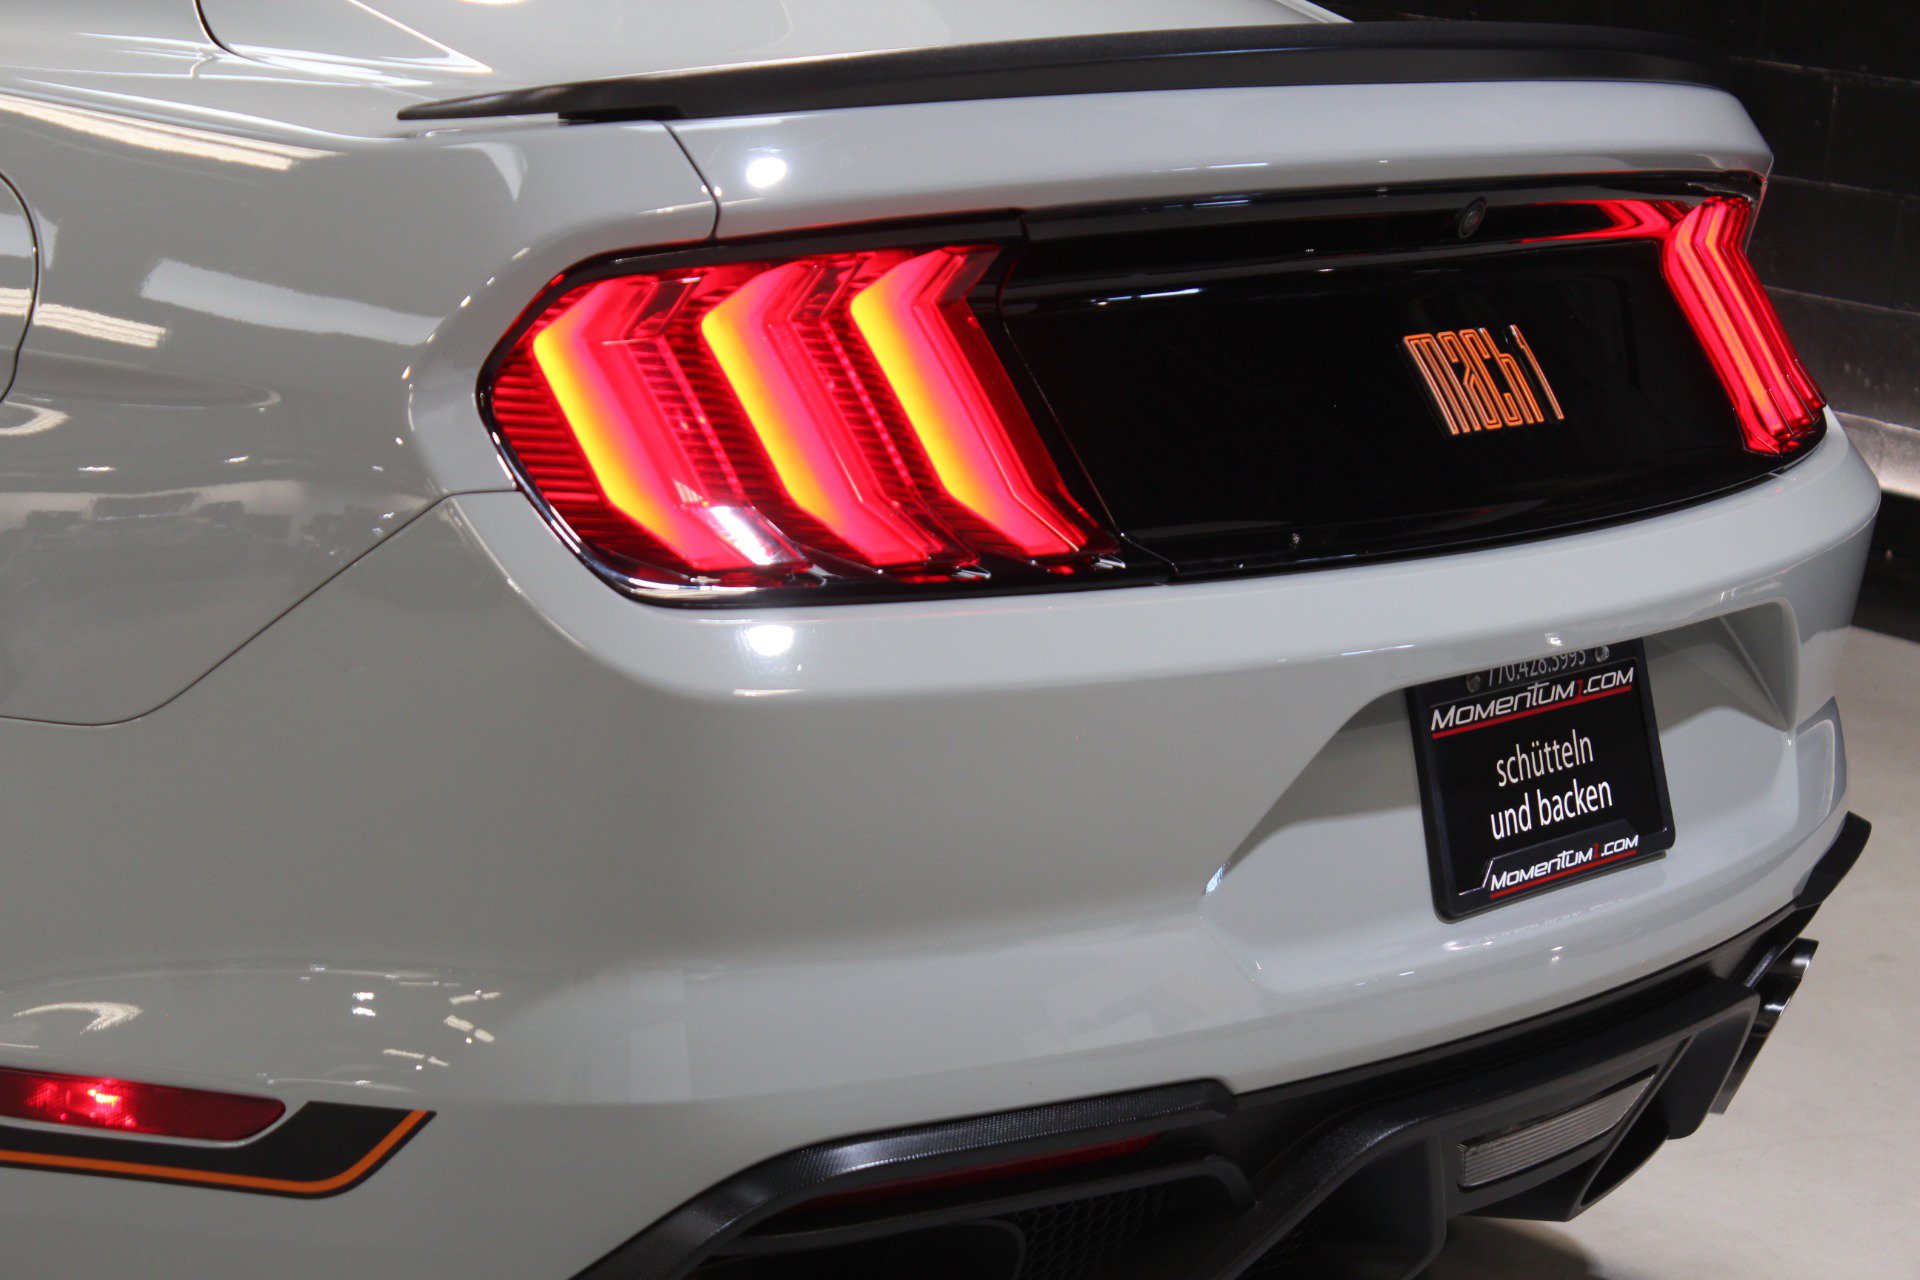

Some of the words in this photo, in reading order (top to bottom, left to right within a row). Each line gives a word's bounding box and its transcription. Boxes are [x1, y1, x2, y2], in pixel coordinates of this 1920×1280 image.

[1509, 324, 1565, 420] 1
[1497, 729, 1594, 787] schütteln
[1491, 792, 1532, 840] und
[1537, 779, 1613, 827] backen
